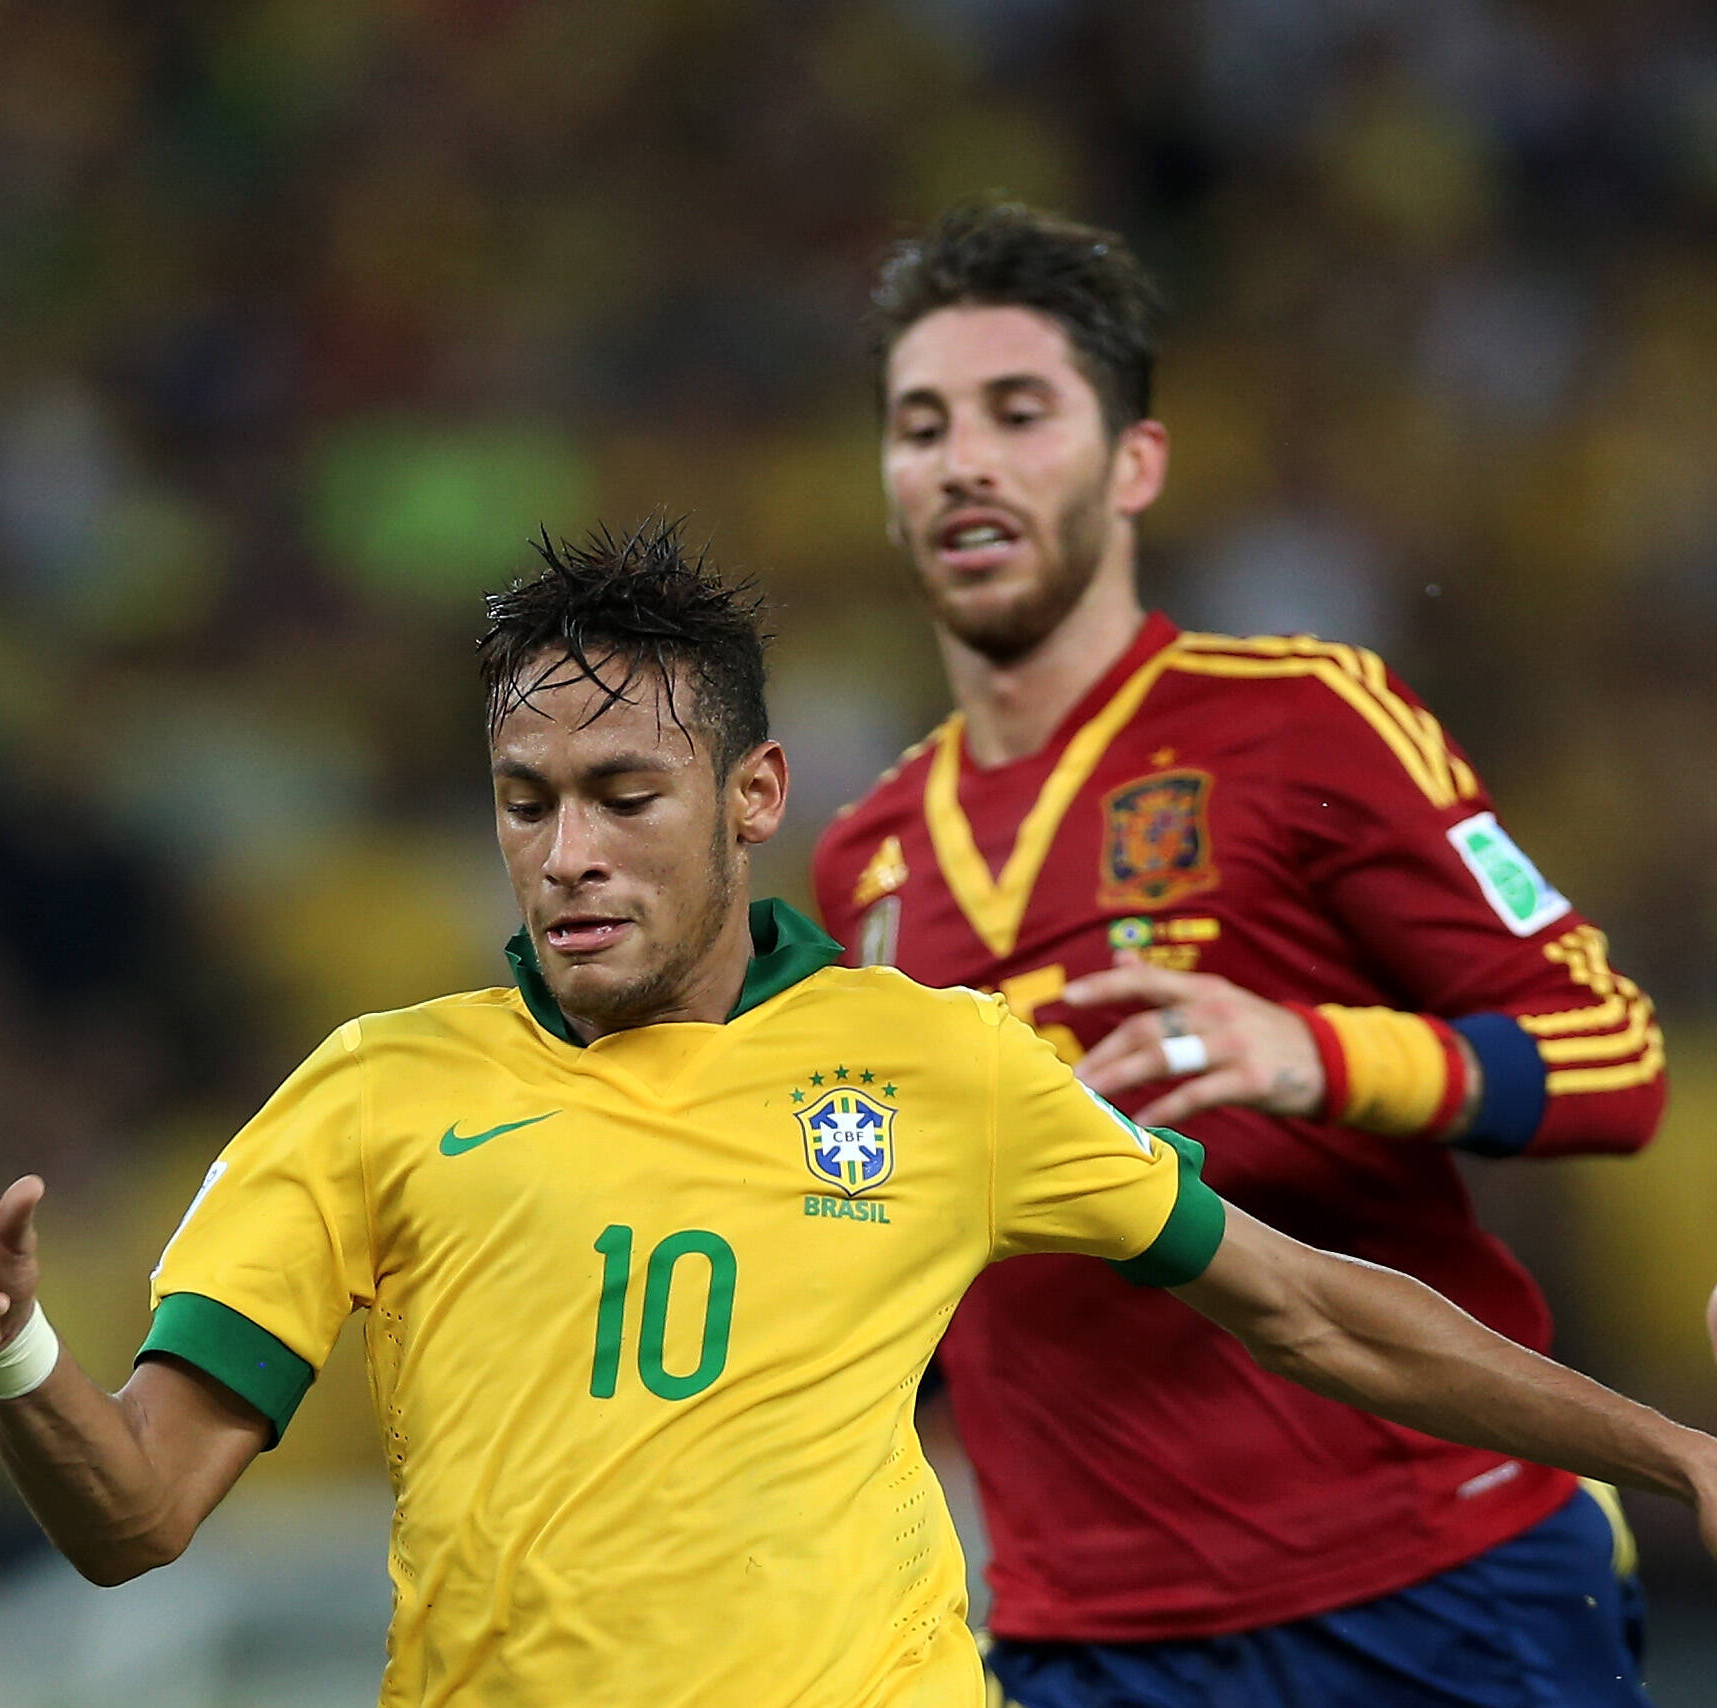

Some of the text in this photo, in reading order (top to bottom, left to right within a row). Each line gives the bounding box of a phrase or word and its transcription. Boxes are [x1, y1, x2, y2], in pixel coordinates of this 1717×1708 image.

[833, 1131, 865, 1143] CBF
[804, 1196, 891, 1224] BRASIL
[590, 1225, 737, 1402] 10
